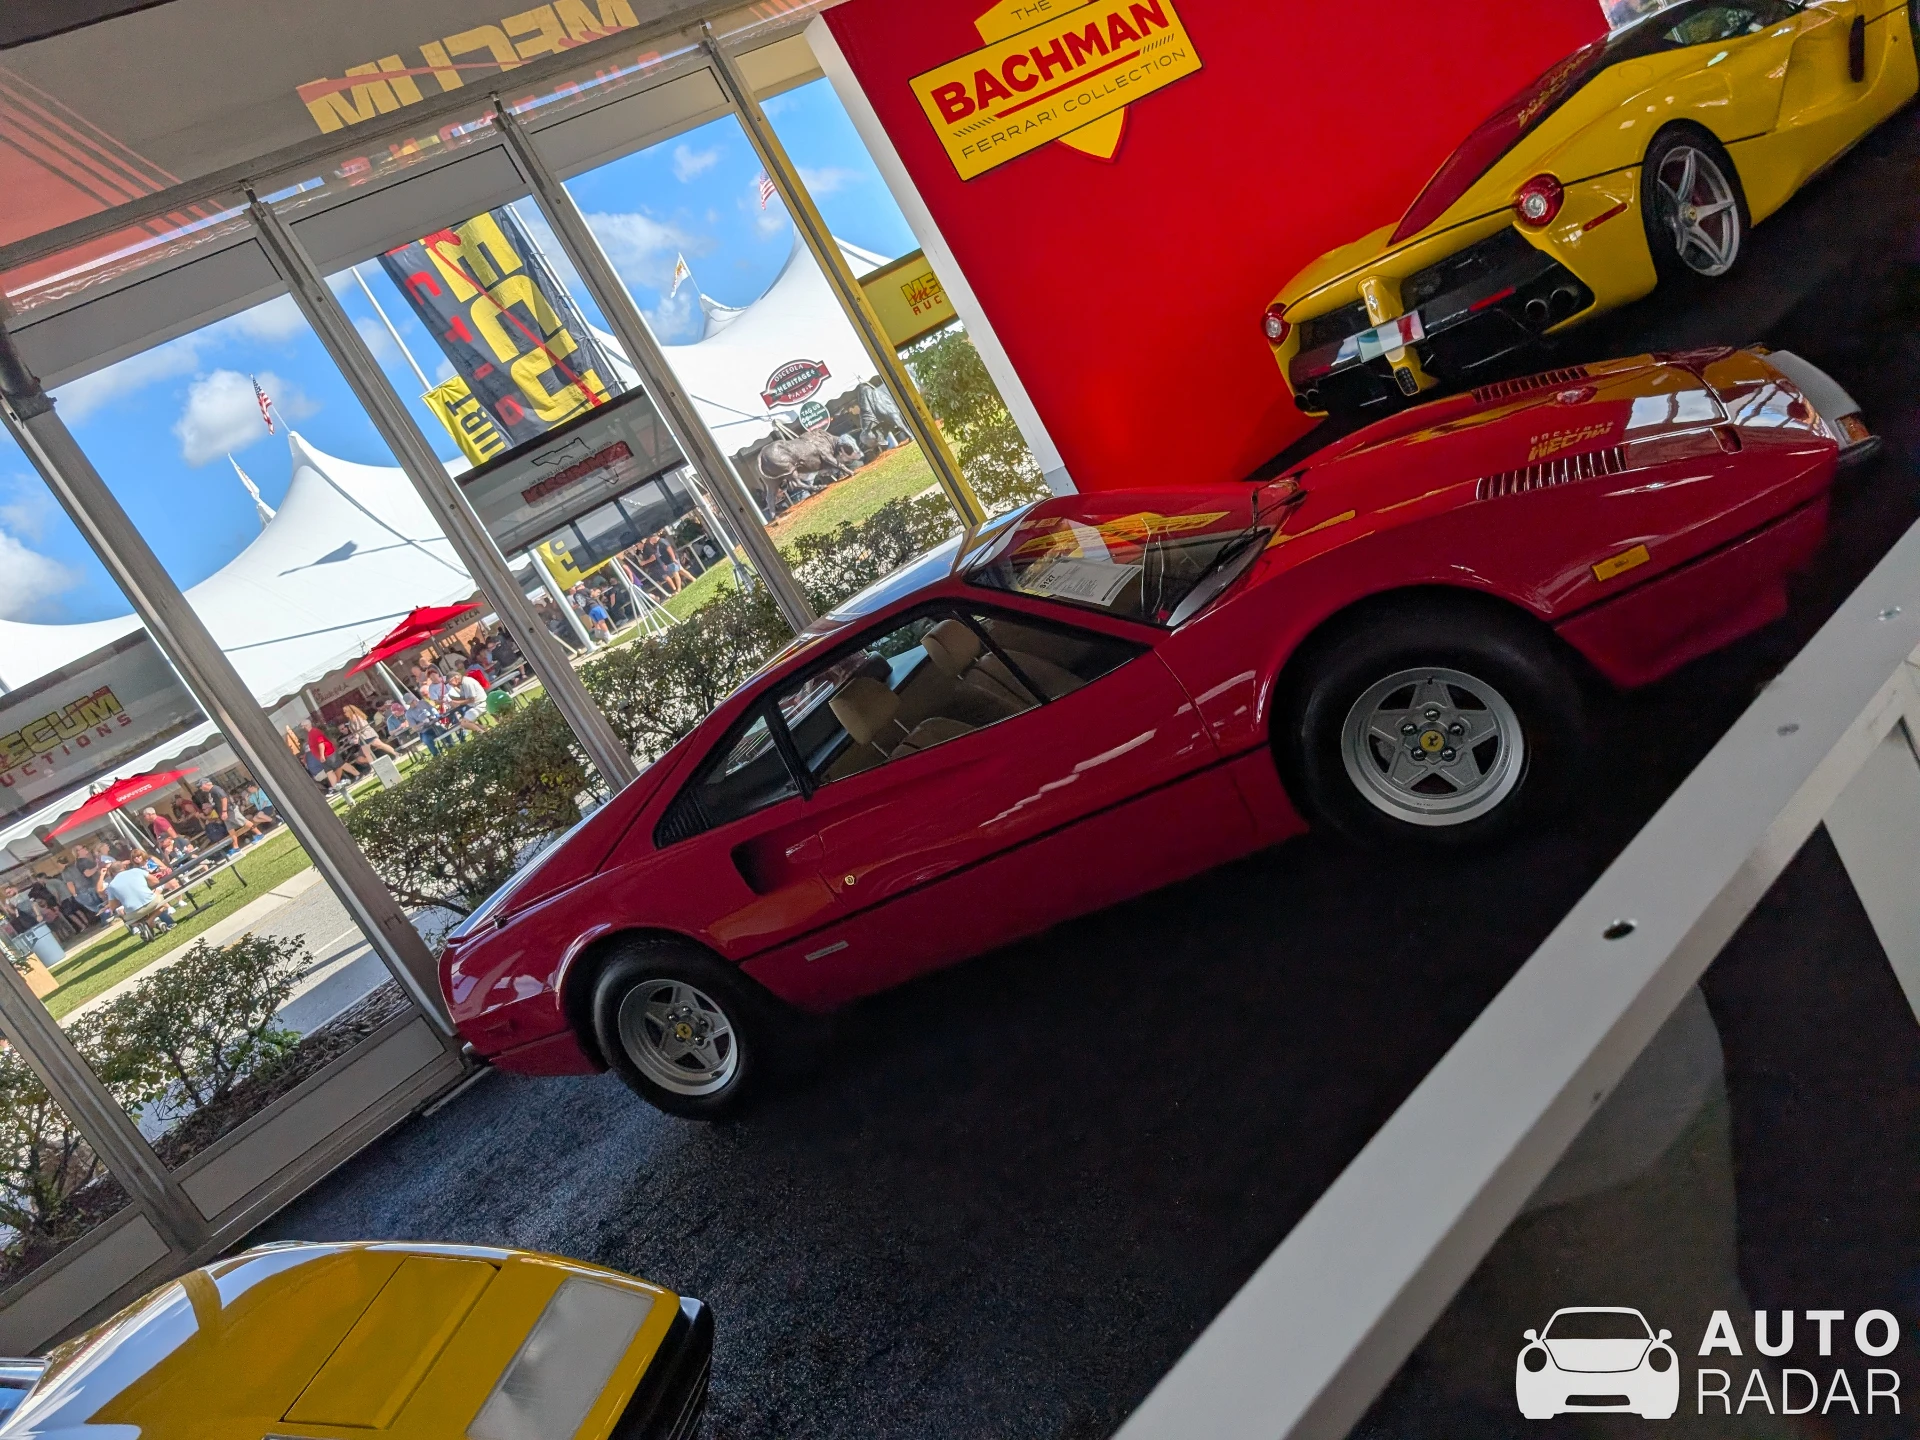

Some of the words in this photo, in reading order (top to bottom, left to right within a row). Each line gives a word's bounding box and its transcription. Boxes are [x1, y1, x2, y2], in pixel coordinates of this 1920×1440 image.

[1010, 0, 1053, 21] THE
[931, 0, 1170, 125] BACHMAN
[961, 108, 1058, 159] FERRARI
[1063, 48, 1186, 112] COLLECTION
[900, 271, 944, 307] ME
[773, 364, 804, 382] OSCEOLA
[777, 371, 812, 393] HERITAGE
[801, 408, 813, 417] TAG
[444, 394, 506, 459] URT
[455, 608, 480, 626] PIZZA
